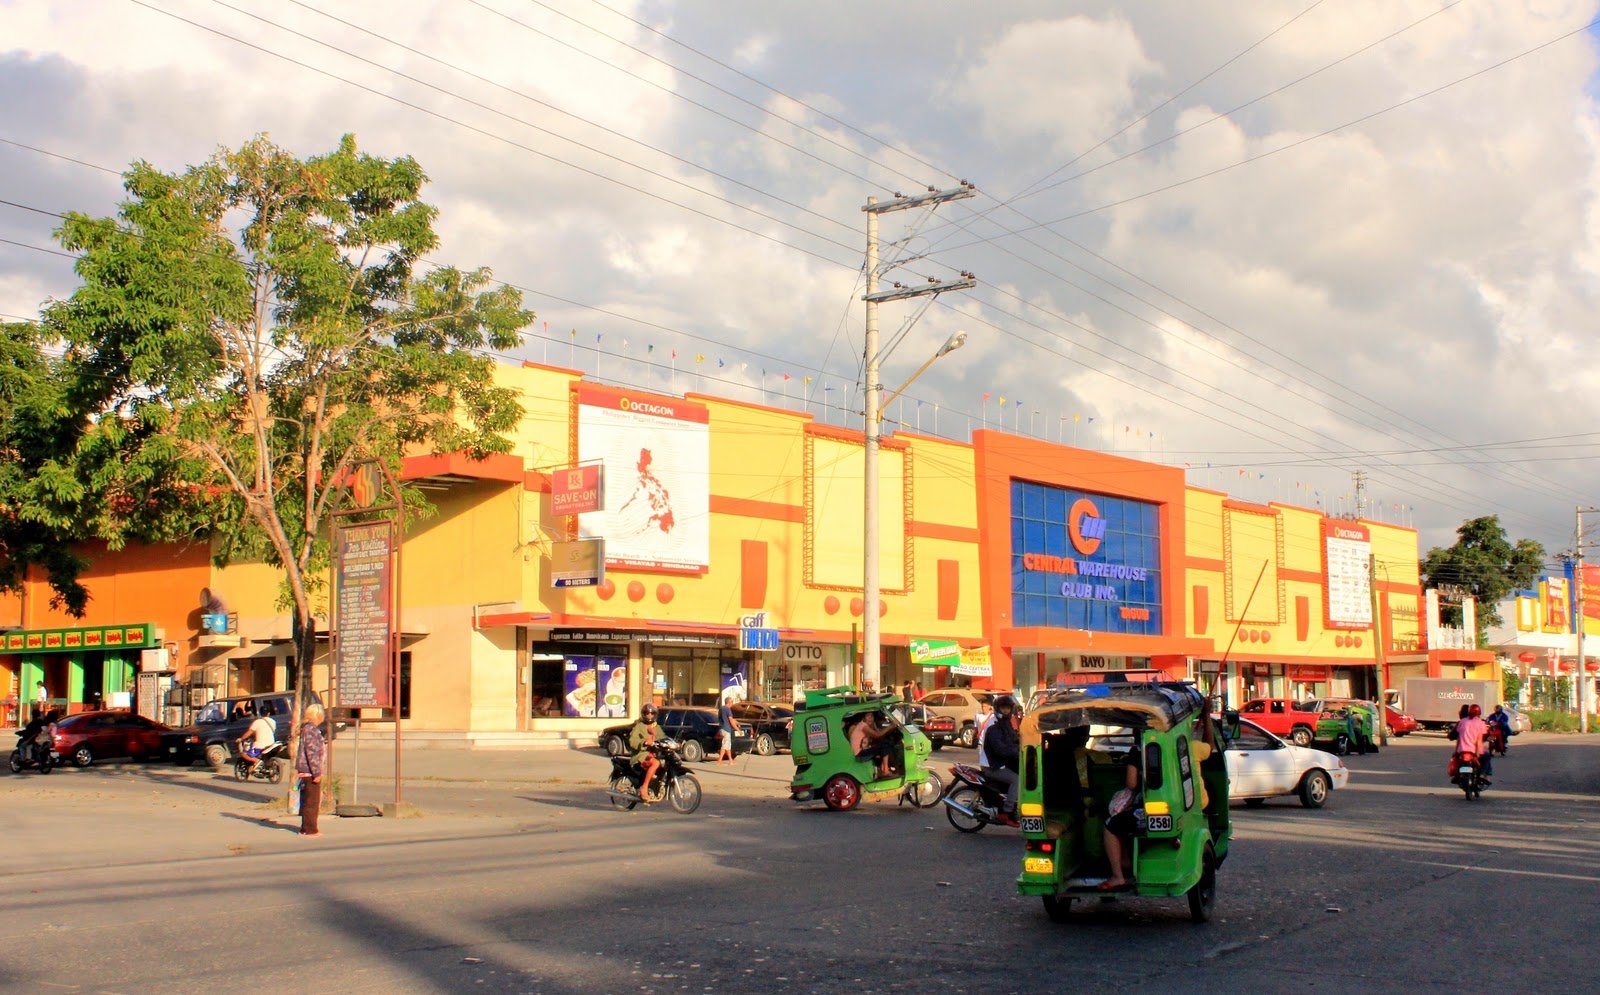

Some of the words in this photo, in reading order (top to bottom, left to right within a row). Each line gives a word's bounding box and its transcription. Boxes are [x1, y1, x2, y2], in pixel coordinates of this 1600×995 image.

[631, 402, 674, 416] OCTAGON
[554, 490, 597, 504] SAVE-ON
[344, 528, 370, 543] THANK
[1340, 529, 1364, 540] OCTAGON
[624, 559, 655, 567] VISAYAS
[662, 562, 700, 570] MINDANAO
[1023, 553, 1078, 574] CENTRAL
[1078, 560, 1146, 581] WAREHOUSE
[1062, 582, 1094, 599] CLUB
[1094, 584, 1118, 601] INC.
[787, 645, 822, 659] OTTO
[917, 648, 929, 656] MILO
[1080, 655, 1105, 668] BAYO
[1022, 818, 1043, 831] 2581
[1149, 817, 1171, 829] 2581
